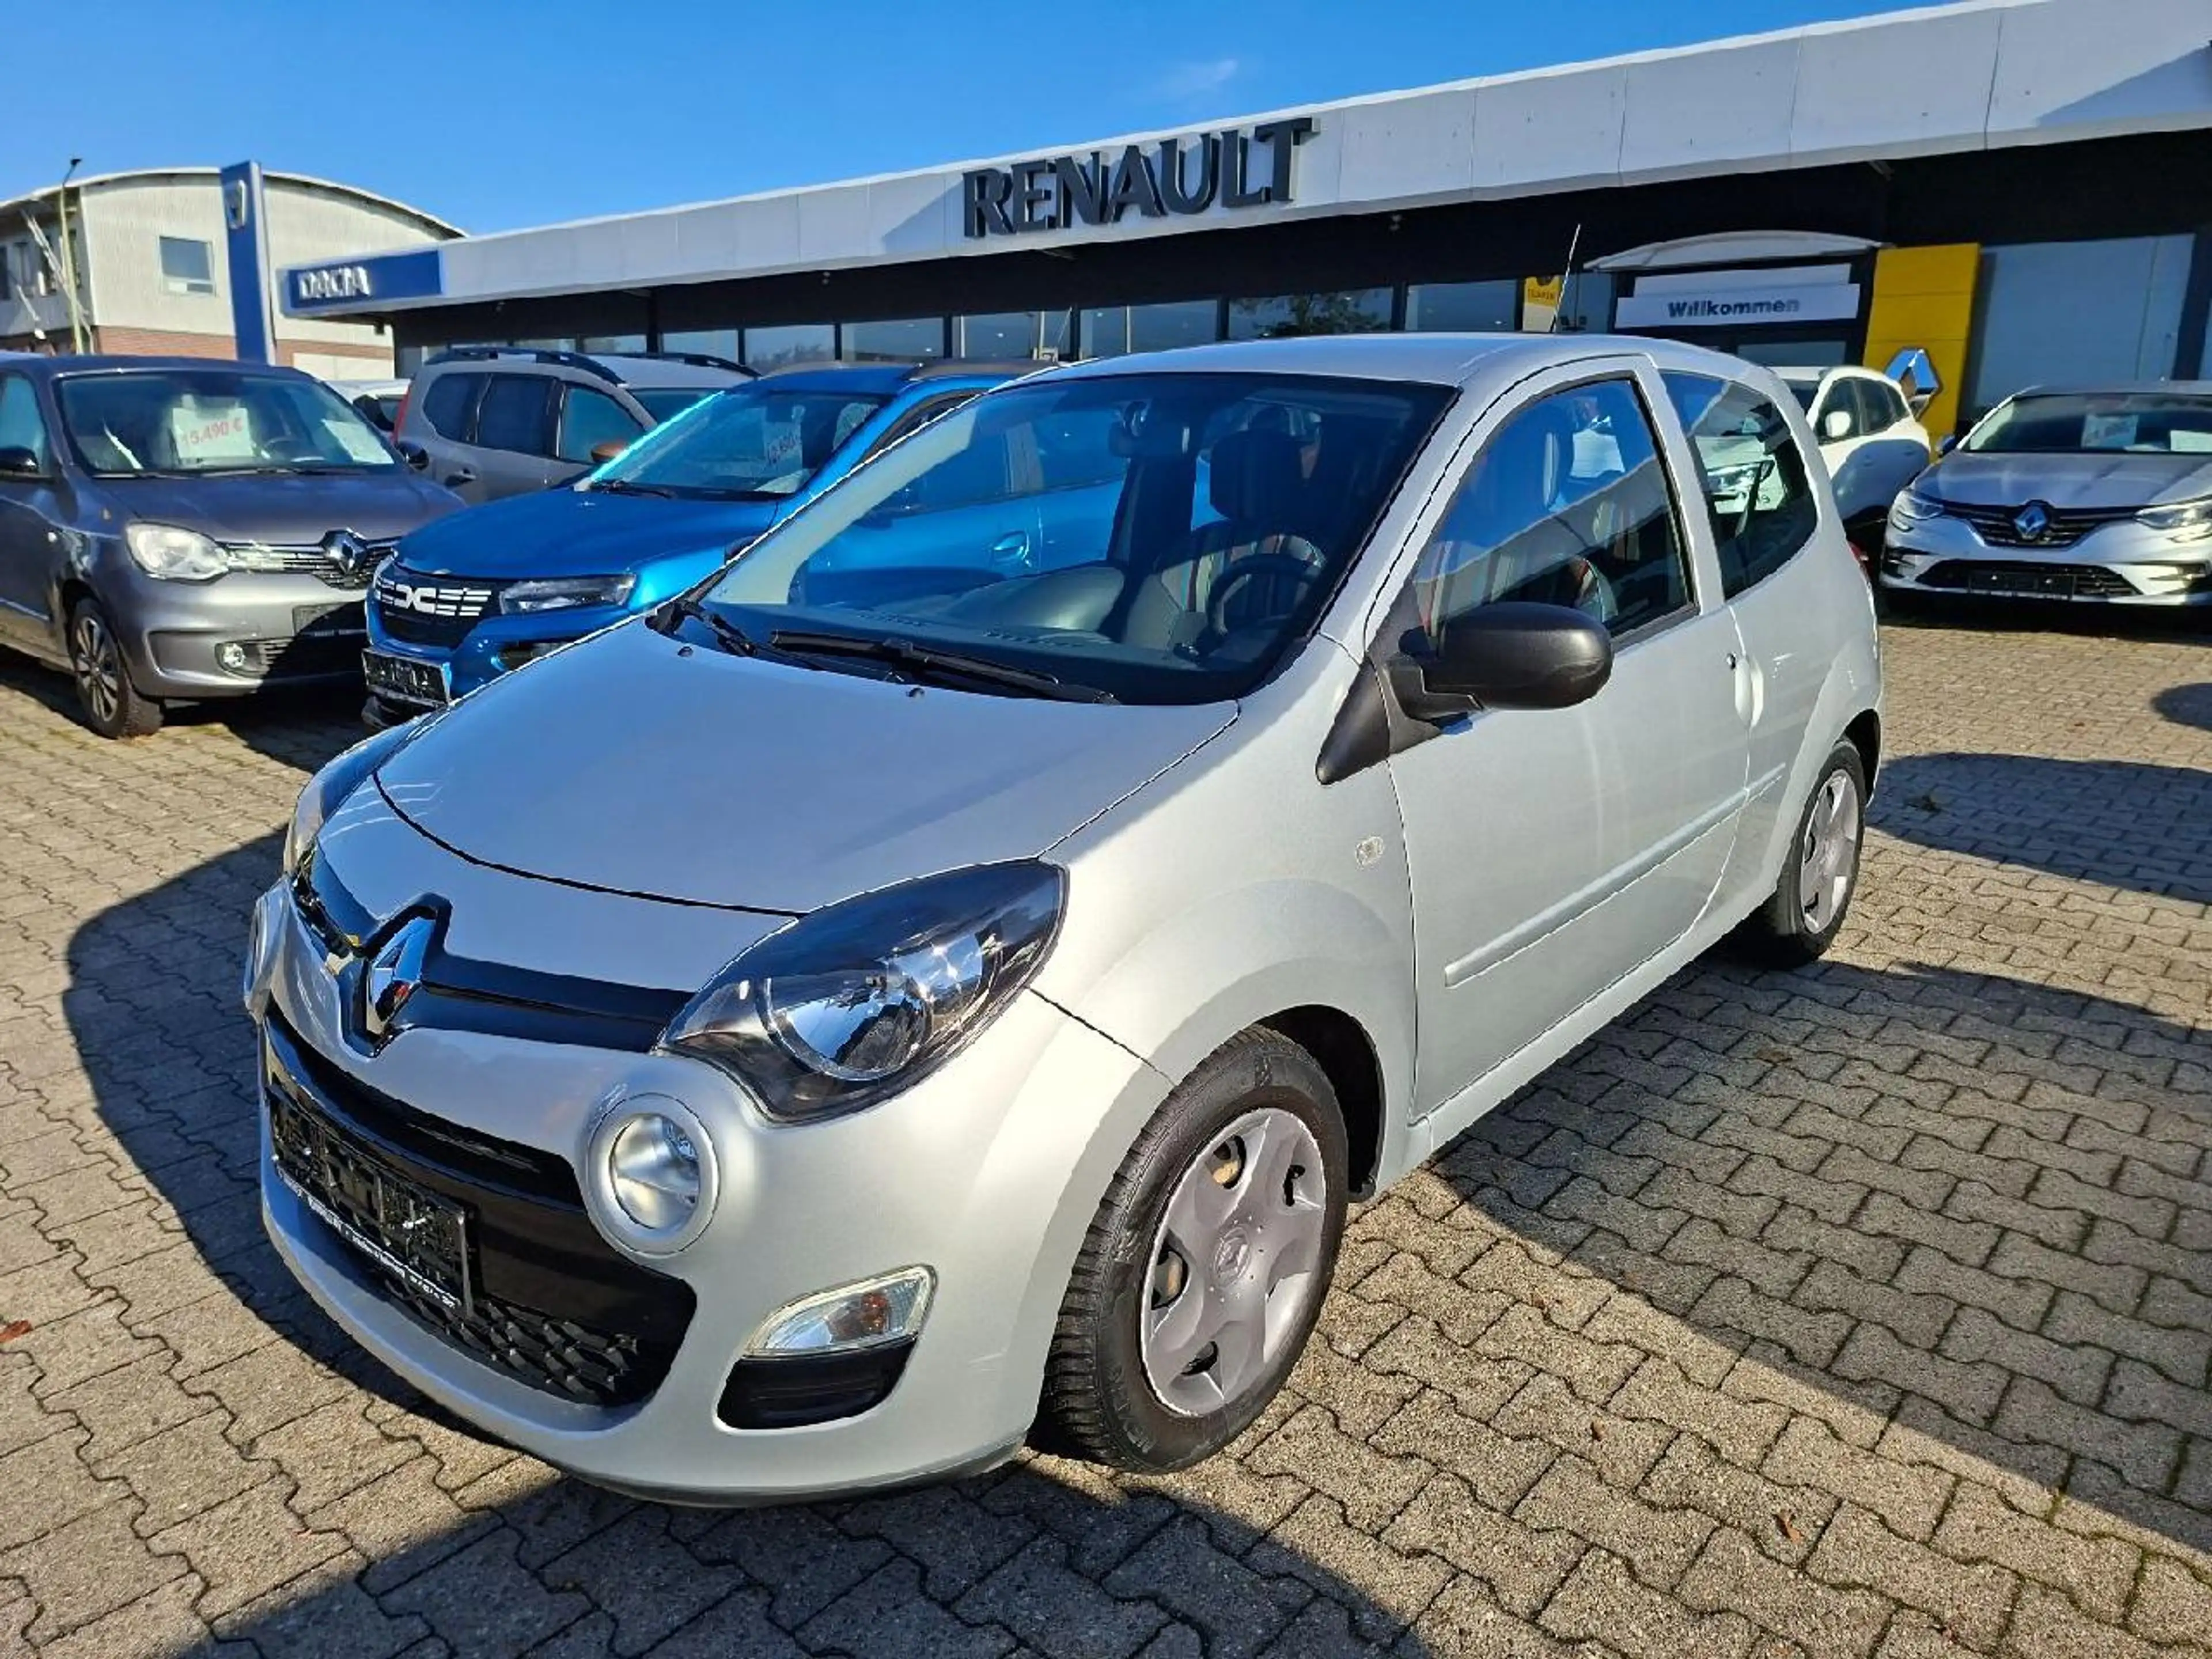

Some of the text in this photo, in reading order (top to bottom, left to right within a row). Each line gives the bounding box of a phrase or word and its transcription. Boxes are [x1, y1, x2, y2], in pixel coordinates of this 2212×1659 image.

[964, 116, 1313, 237] RENAULT
[298, 267, 370, 300] DACIA
[1668, 298, 1801, 318] Willkommen
